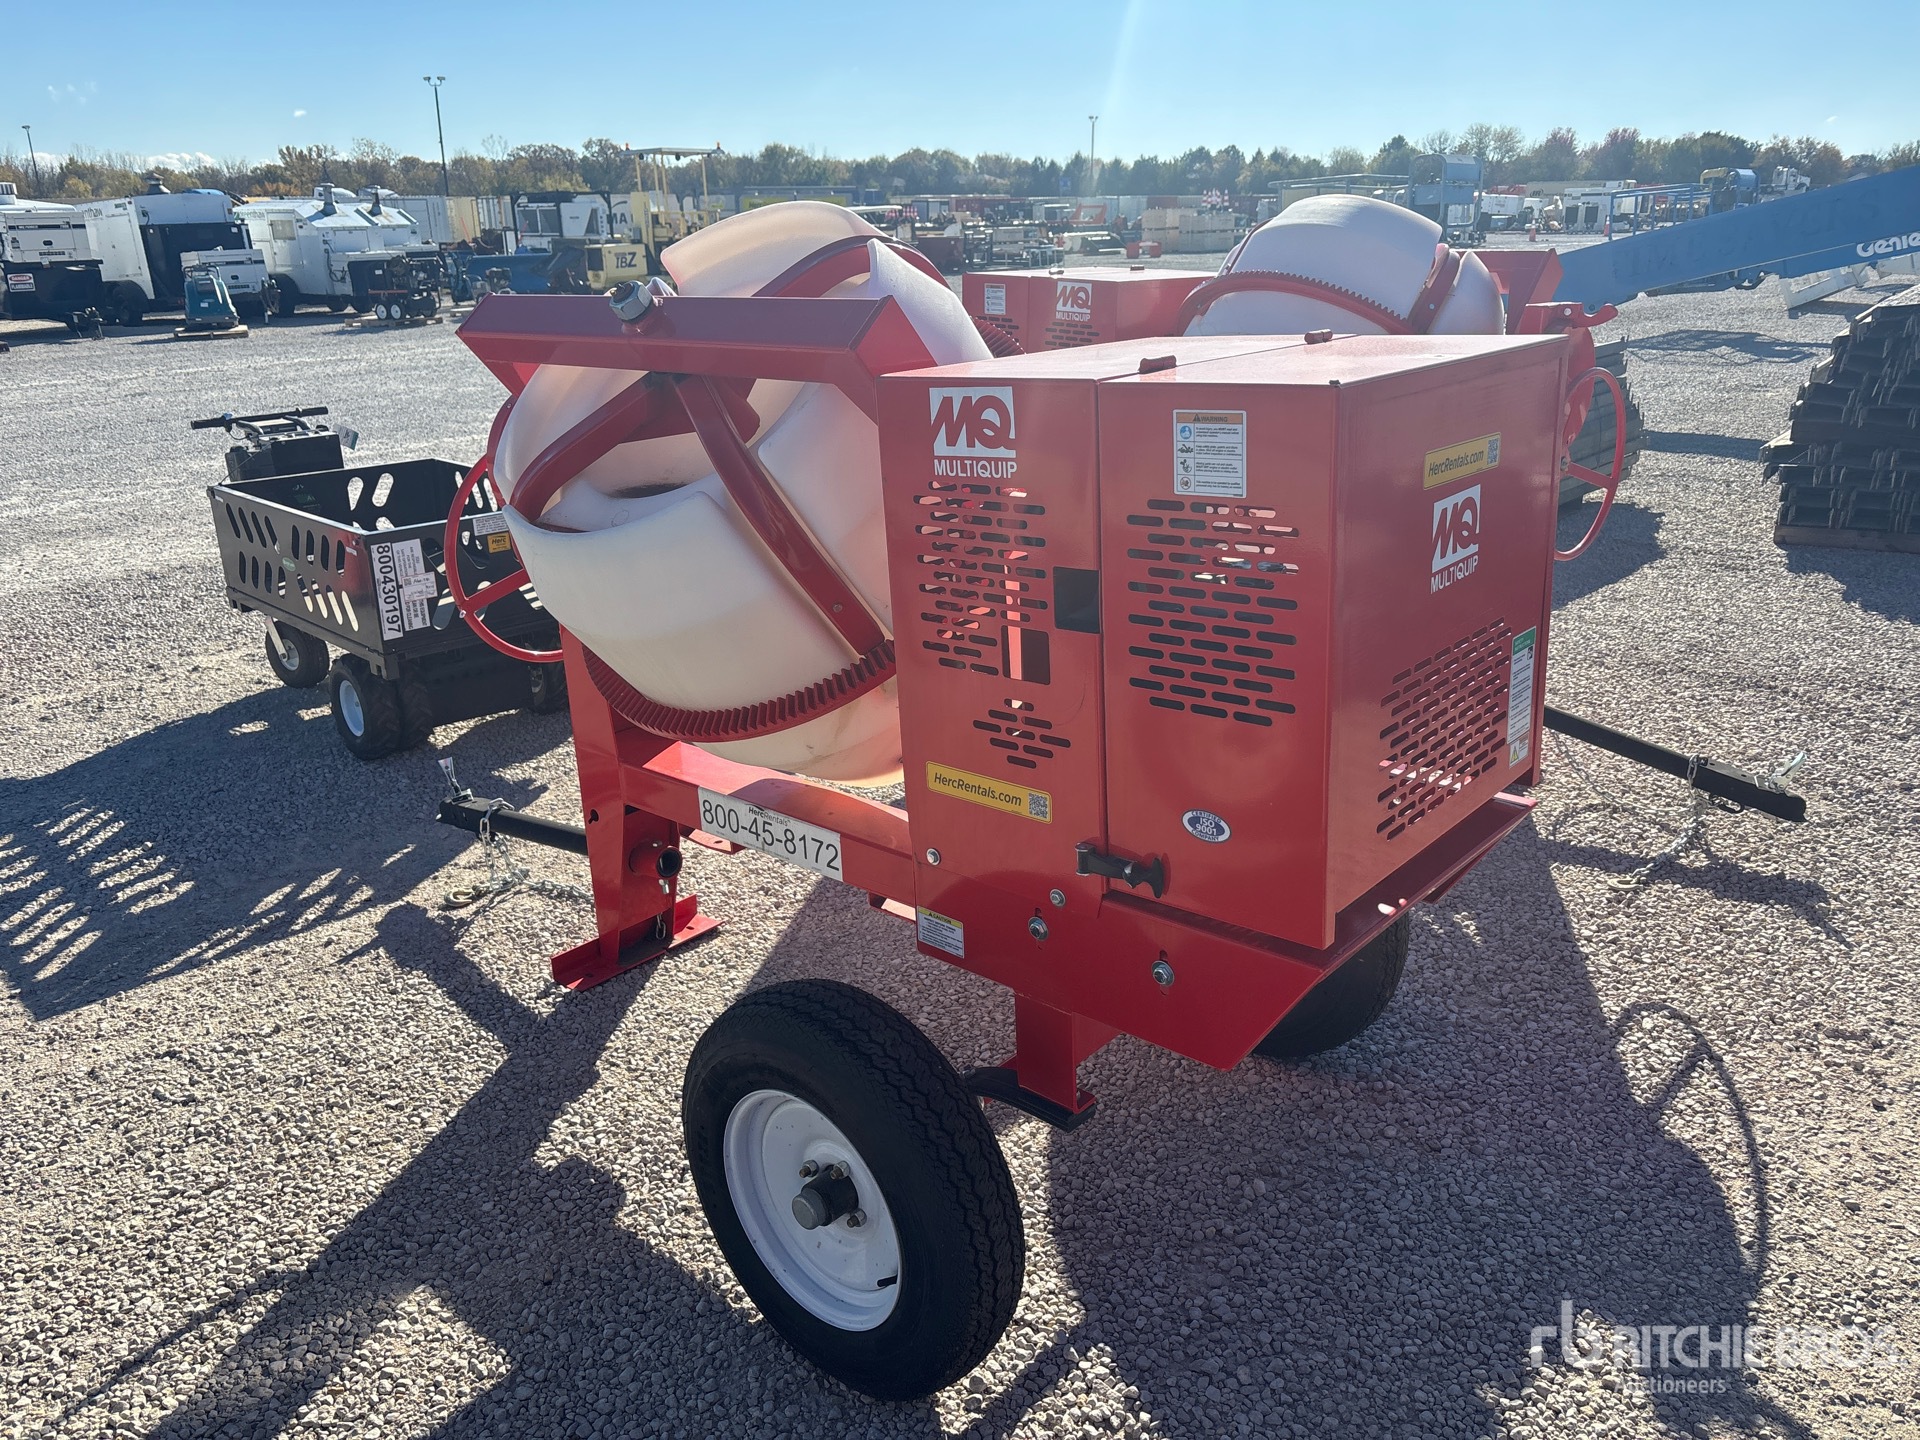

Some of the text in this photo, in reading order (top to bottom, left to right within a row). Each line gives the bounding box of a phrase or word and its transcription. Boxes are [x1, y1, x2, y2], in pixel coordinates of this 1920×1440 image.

[1856, 232, 1920, 258] Genie
[1056, 285, 1091, 309] MQ
[1056, 312, 1091, 322] MULTIQUIP
[930, 394, 1016, 450] MQ
[934, 459, 1018, 479] MULTIQUIP
[1428, 450, 1484, 477] HercRentals.com
[1432, 496, 1479, 560] MQ
[1430, 555, 1479, 594] MULTIQUIP
[375, 544, 402, 633] 800430197
[934, 772, 1022, 806] HercRentals.com
[1191, 811, 1222, 823] CERTIFIED
[1196, 823, 1217, 836] 9001
[1200, 818, 1214, 828] ISO
[702, 799, 840, 871] 800-45-8172
[1192, 829, 1220, 841] COMPANY
